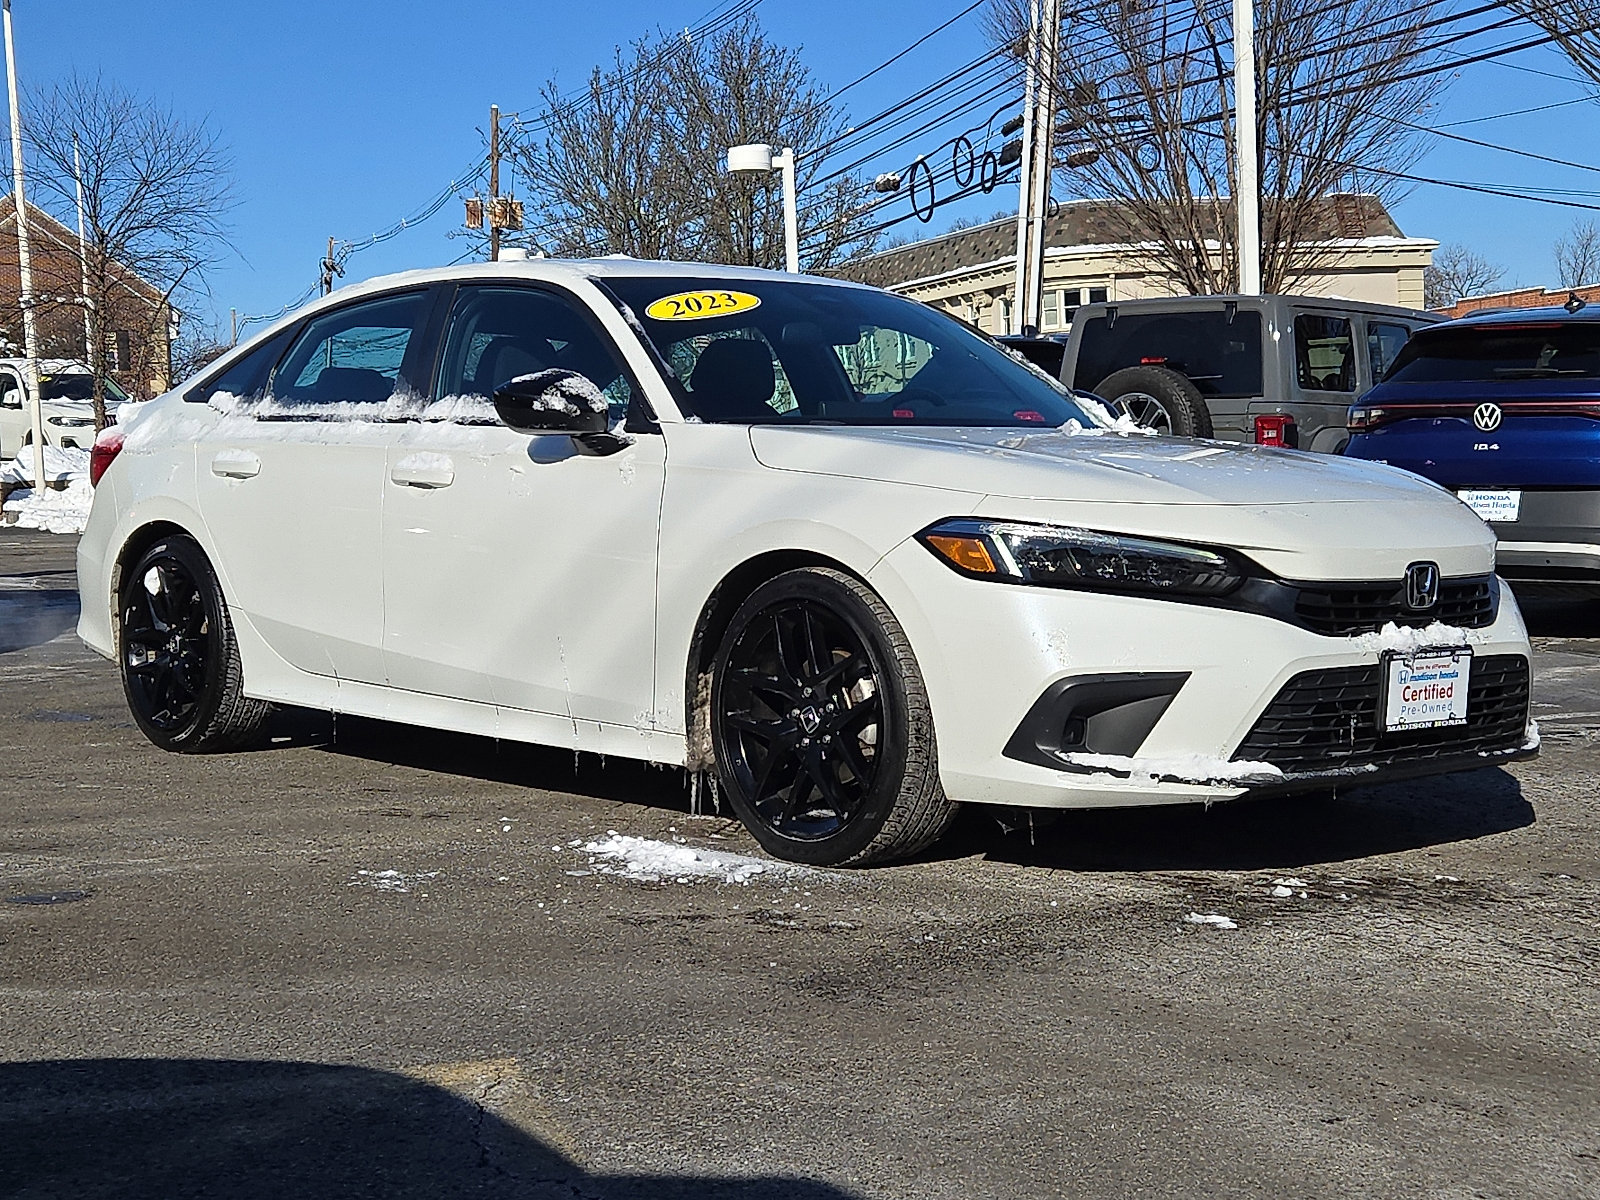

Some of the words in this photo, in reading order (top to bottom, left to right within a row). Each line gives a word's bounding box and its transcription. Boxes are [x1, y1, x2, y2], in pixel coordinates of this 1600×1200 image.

[666, 293, 737, 316] 2023
[1402, 681, 1454, 702] Certified
[1401, 701, 1453, 715] Pre-Owned
[1386, 722, 1432, 732] MADISON
[1434, 719, 1467, 727] HONDA
